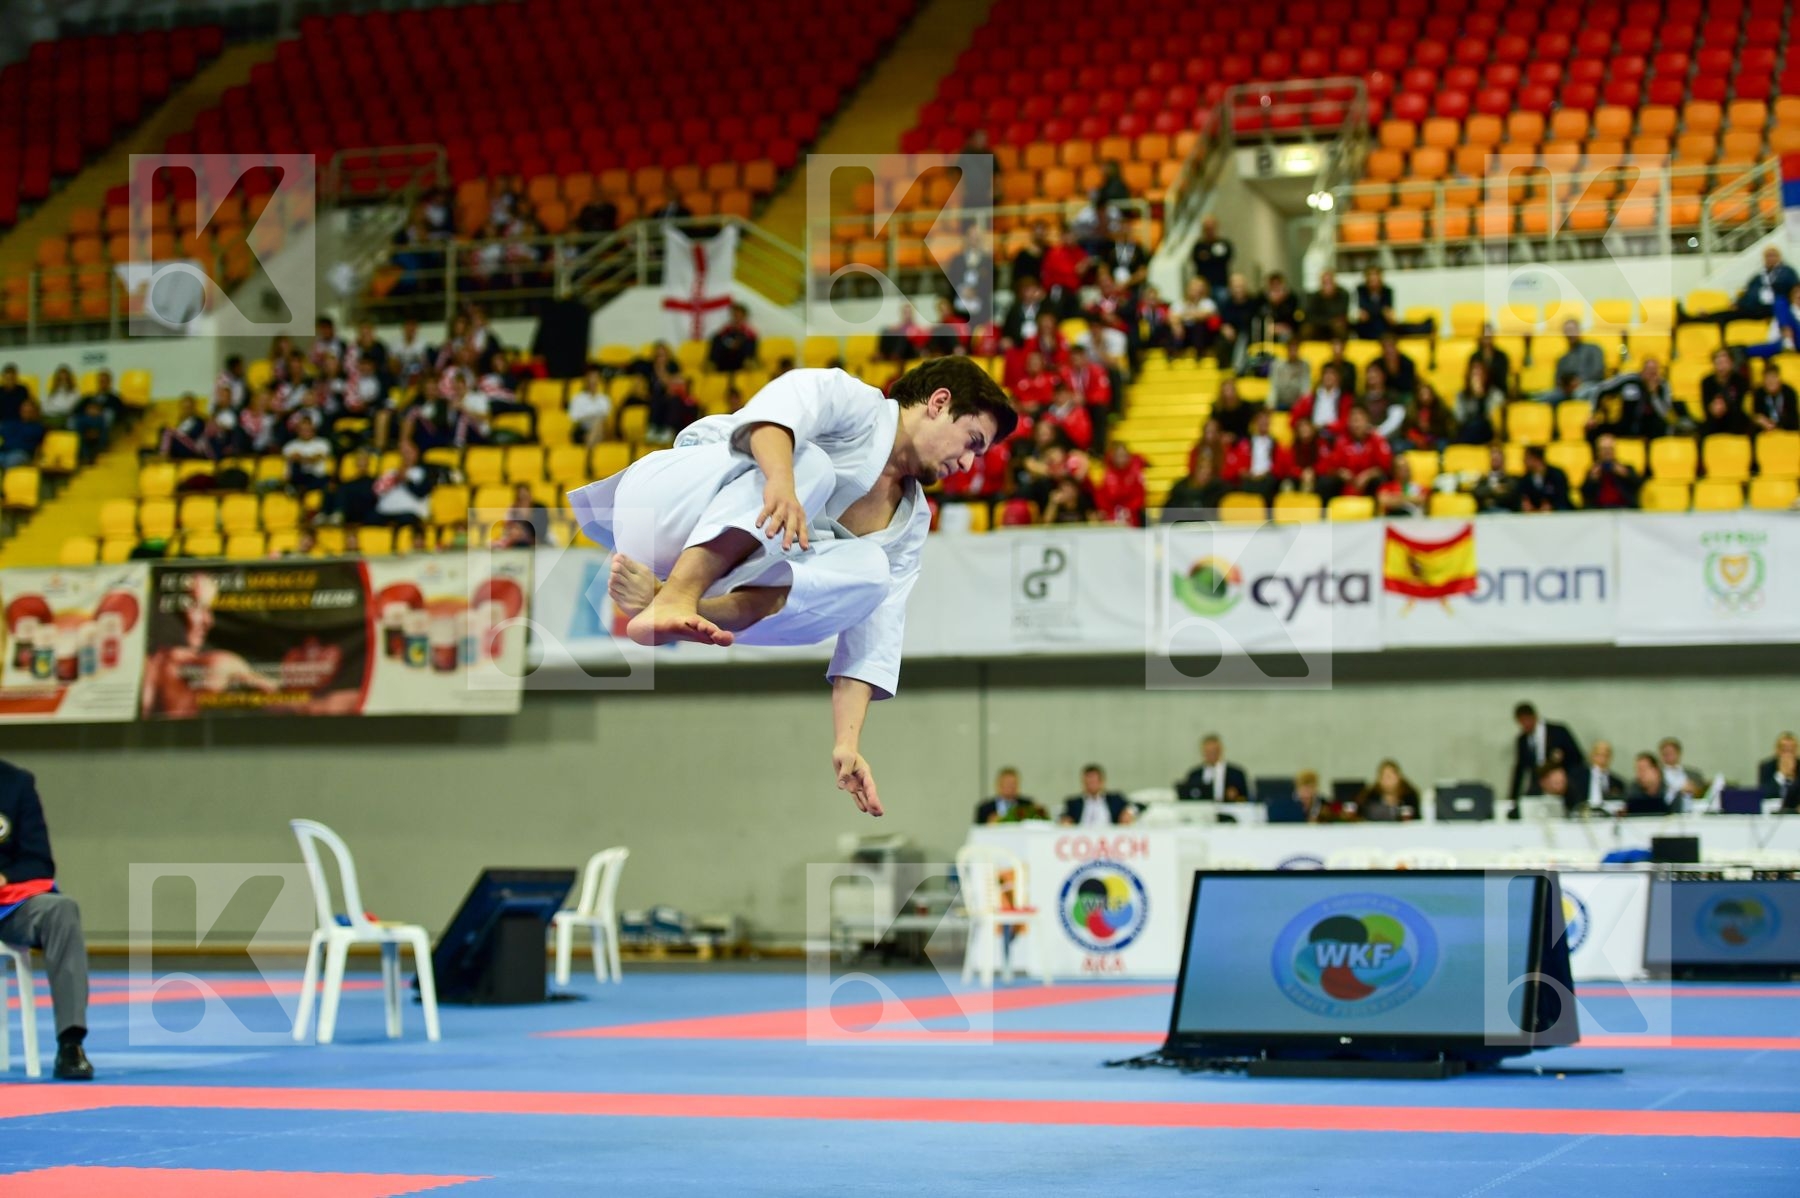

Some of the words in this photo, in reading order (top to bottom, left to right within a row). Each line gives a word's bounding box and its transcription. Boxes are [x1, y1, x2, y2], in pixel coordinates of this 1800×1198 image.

[1250, 566, 1371, 621] cyta
[1054, 836, 1150, 861] COACH
[1081, 957, 1127, 972] AKA
[1315, 942, 1393, 969] WKF
